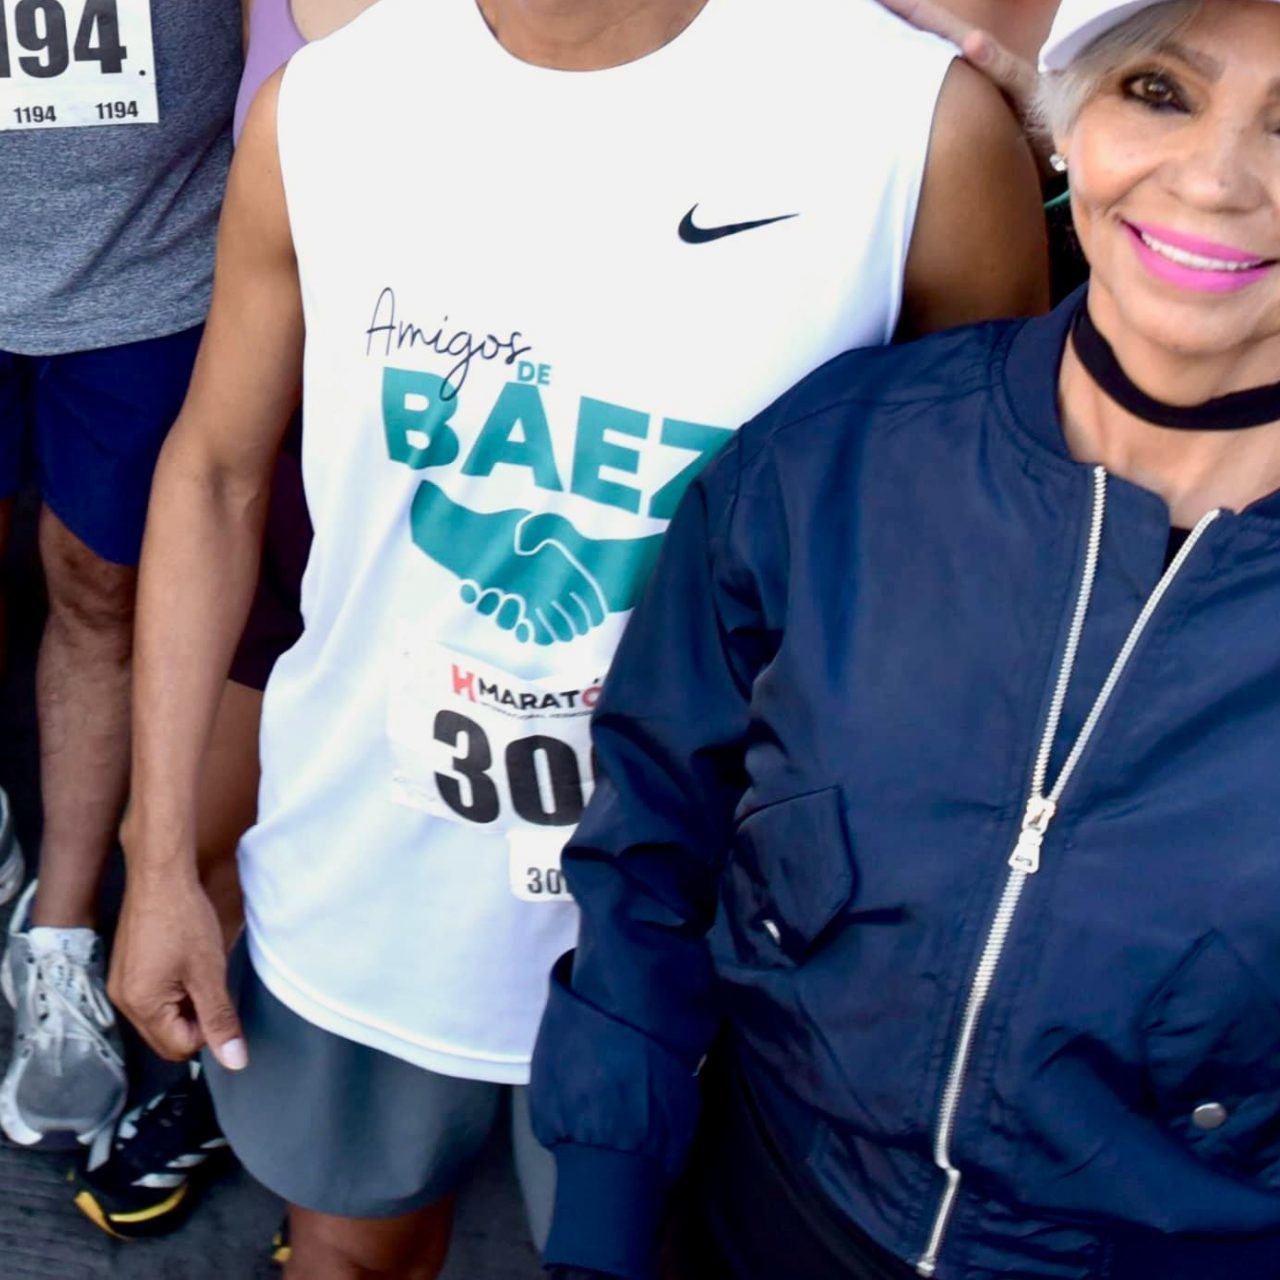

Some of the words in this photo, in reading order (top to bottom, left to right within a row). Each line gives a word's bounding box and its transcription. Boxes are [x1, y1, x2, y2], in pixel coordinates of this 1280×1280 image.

[13, 105, 57, 124] 1194
[95, 100, 139, 120] 1194
[366, 286, 531, 402] Amigos
[517, 360, 551, 385] DE
[381, 366, 738, 521] BAEZ
[433, 709, 598, 827] 30
[527, 867, 573, 894] 30
